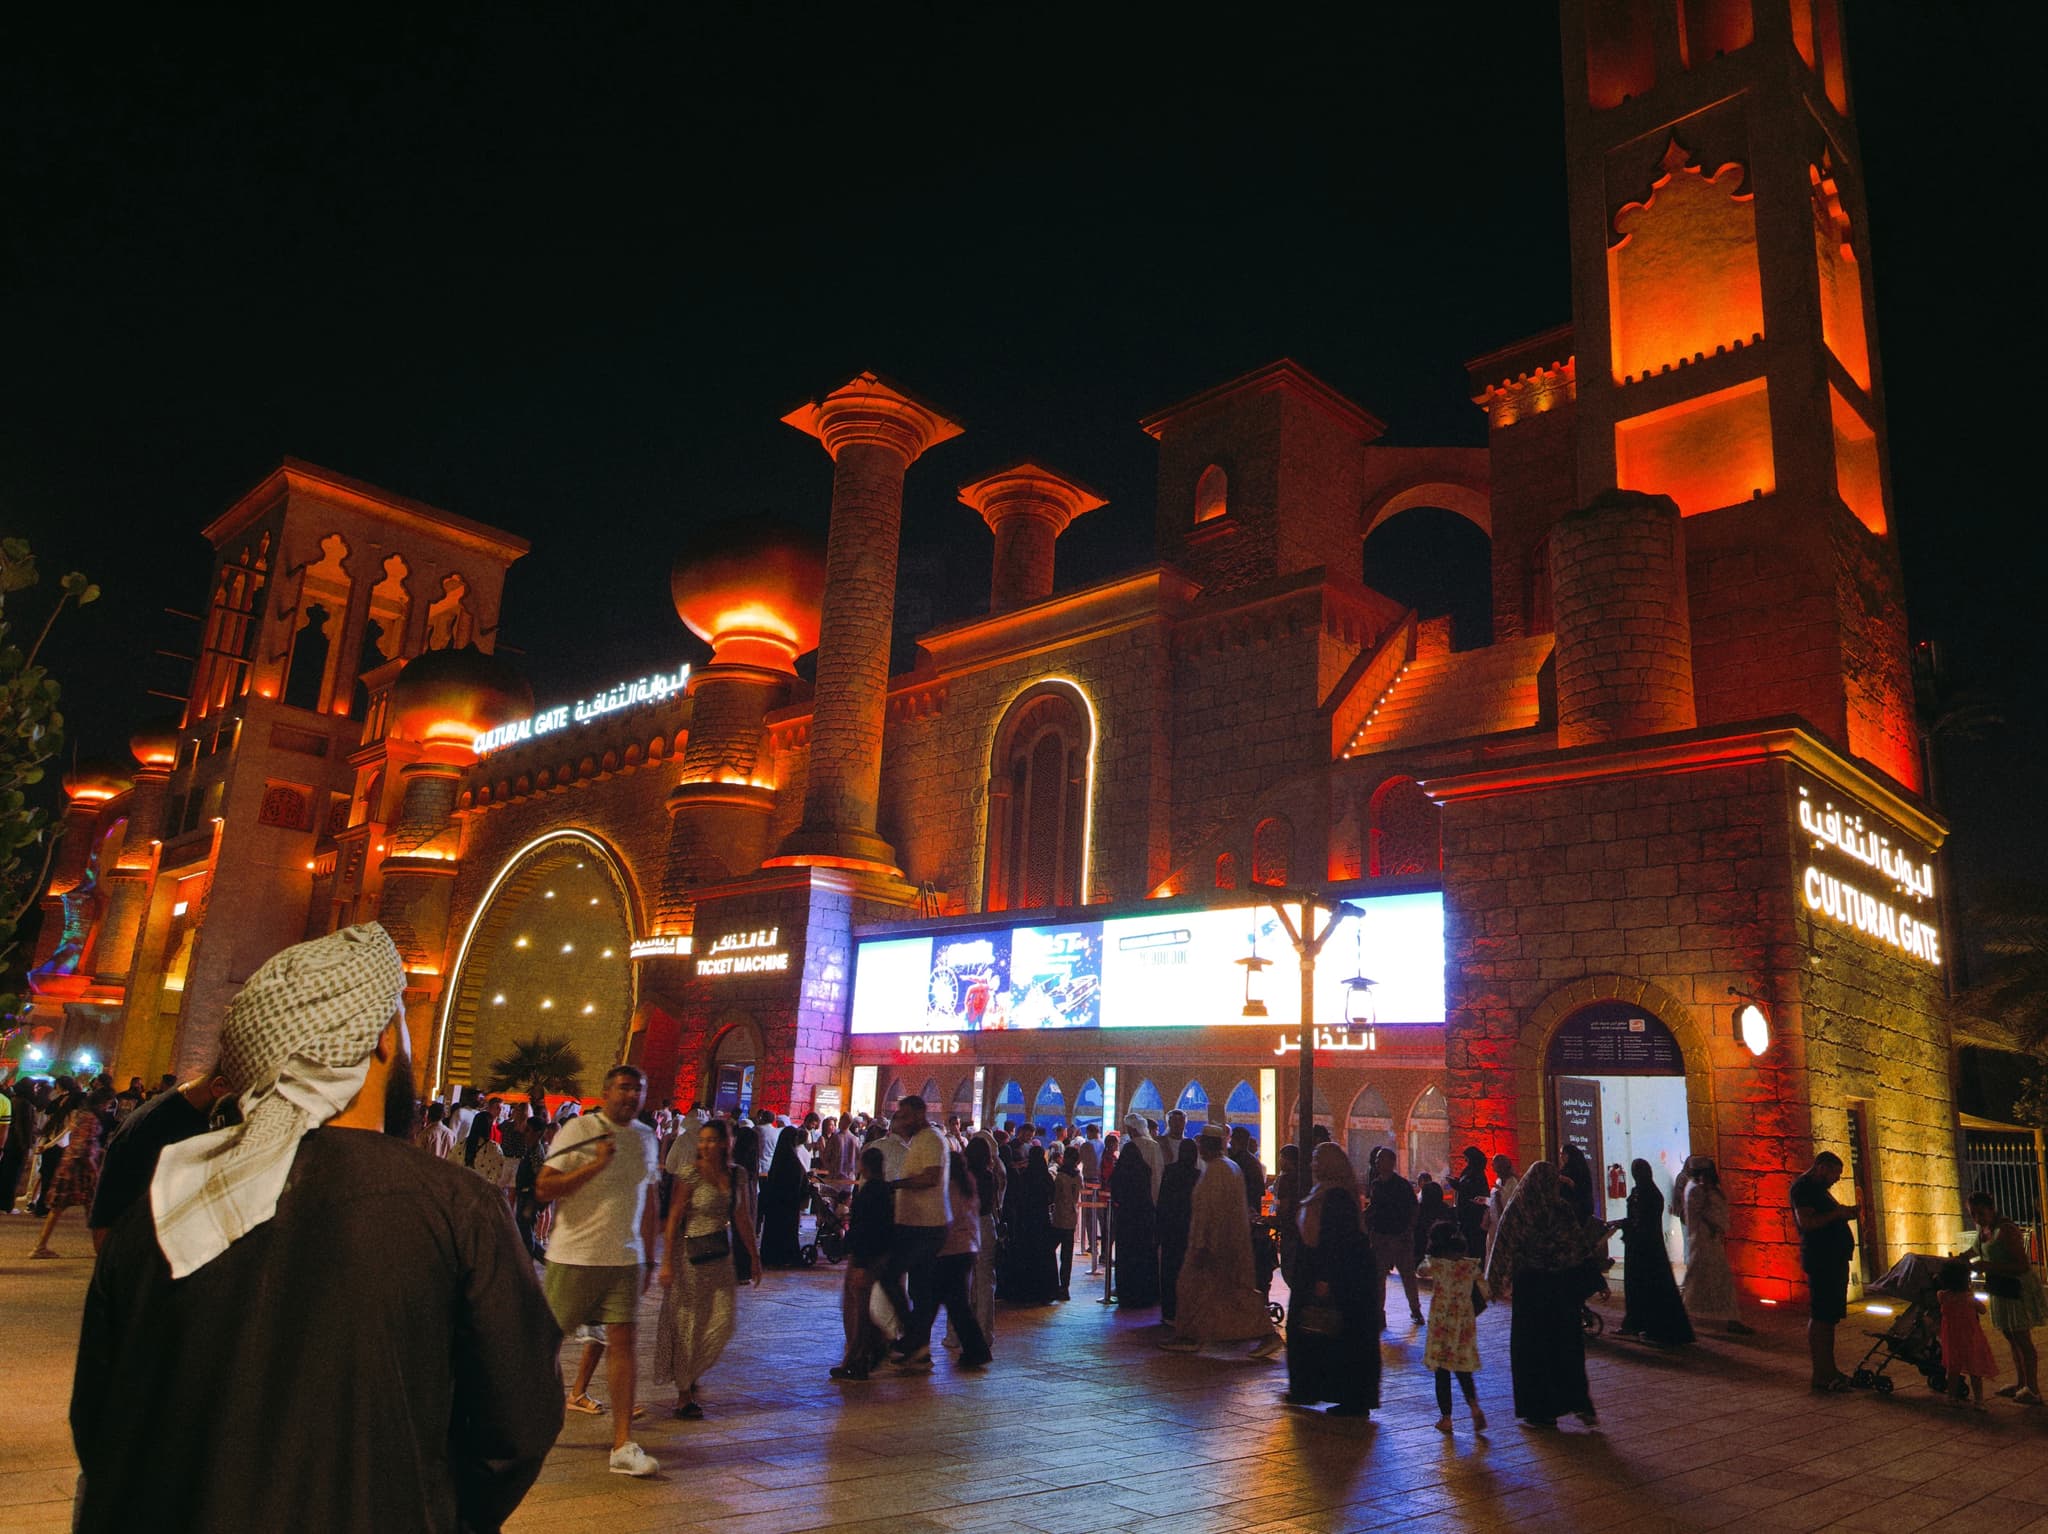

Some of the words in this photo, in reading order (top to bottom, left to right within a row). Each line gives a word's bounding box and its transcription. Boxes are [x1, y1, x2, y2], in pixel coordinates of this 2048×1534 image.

[574, 682, 637, 725] الثقافية
[473, 719, 532, 753] CULTURAL
[535, 705, 569, 733] GATE
[1799, 786, 1880, 869] الثقافية
[1880, 837, 1934, 903] البوابة
[1804, 866, 1899, 946] CULTURAL
[1899, 913, 1940, 965] GATE
[697, 957, 733, 975] TICKET
[734, 953, 789, 973] MACHINE
[708, 932, 757, 956] التذاكر
[899, 1034, 960, 1054] TICKETS
